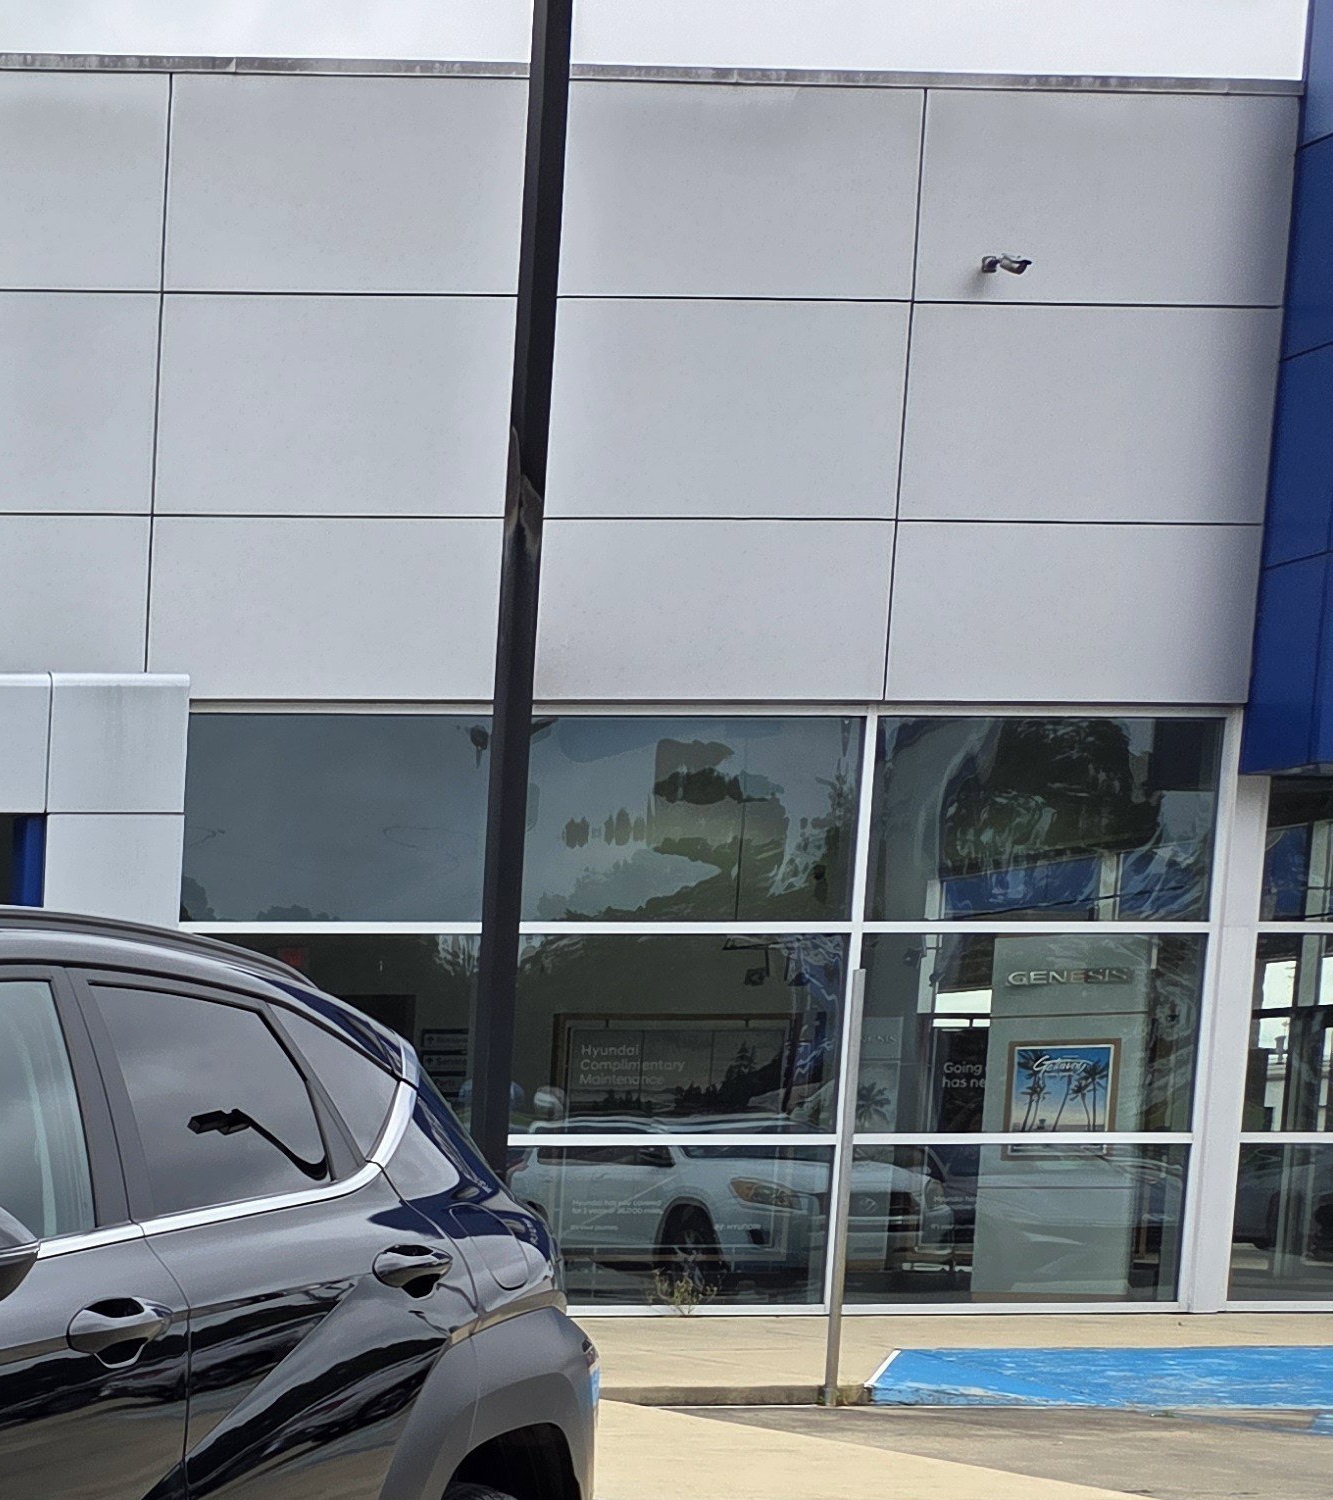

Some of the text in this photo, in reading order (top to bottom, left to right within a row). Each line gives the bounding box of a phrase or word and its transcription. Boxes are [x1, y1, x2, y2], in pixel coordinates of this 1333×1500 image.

[1007, 968, 1129, 985] GENESIS
[581, 1044, 639, 1059] Hyundai
[579, 1059, 686, 1073] Complimentary
[943, 1062, 983, 1076] Going
[579, 1073, 665, 1086] Maintenance
[941, 1076, 967, 1088] has
